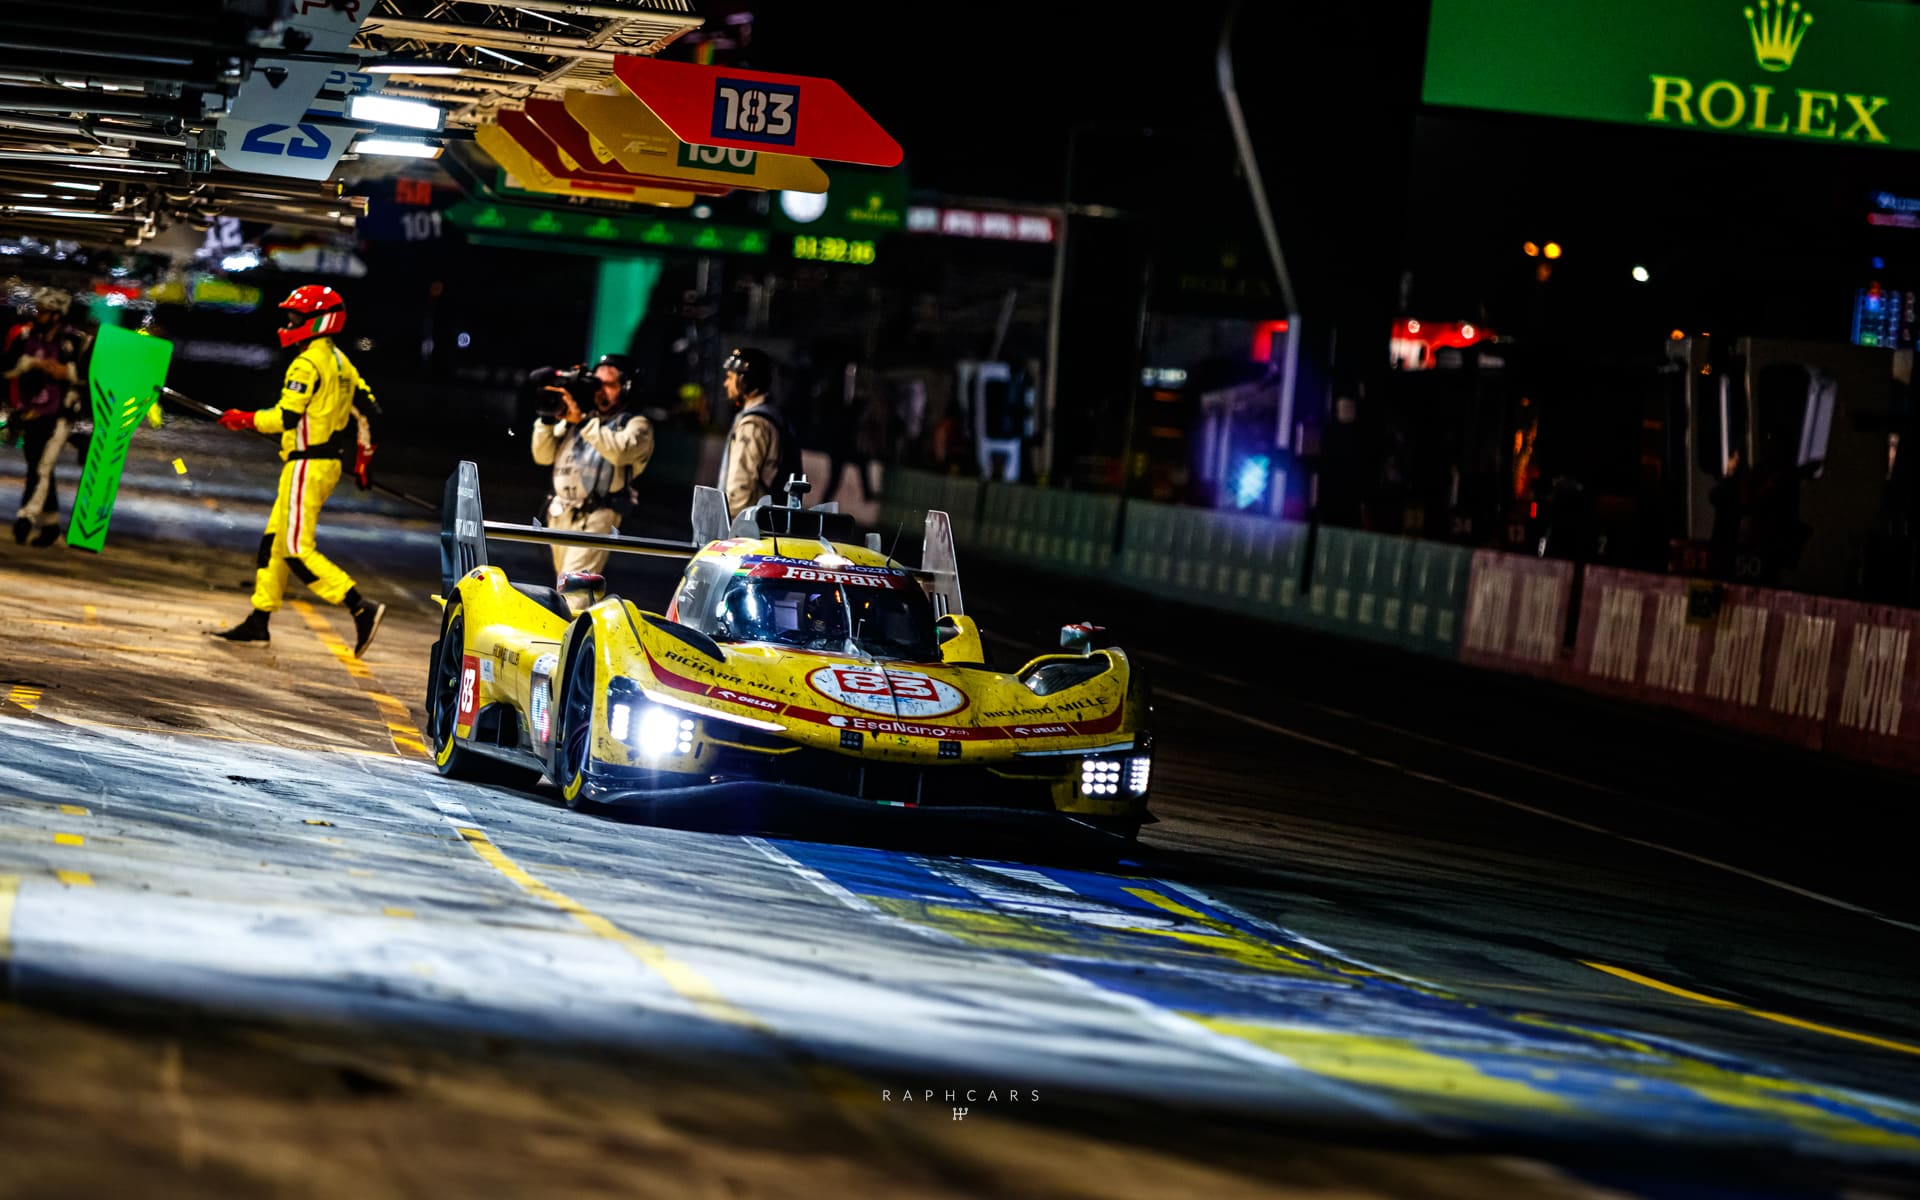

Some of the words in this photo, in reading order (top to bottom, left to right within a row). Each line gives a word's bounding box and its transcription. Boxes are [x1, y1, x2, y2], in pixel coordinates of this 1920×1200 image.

[719, 87, 794, 136] 183
[1646, 74, 1889, 144] ROLEX
[402, 211, 442, 240] 101
[781, 566, 895, 590] Ferrari
[664, 650, 742, 685] RICHARD
[747, 680, 800, 698] MILLE
[841, 673, 933, 697] 83
[461, 668, 476, 713] 83
[738, 695, 778, 710] ORLEN
[983, 705, 1053, 719] RICHARD
[1057, 696, 1109, 713] MILLE
